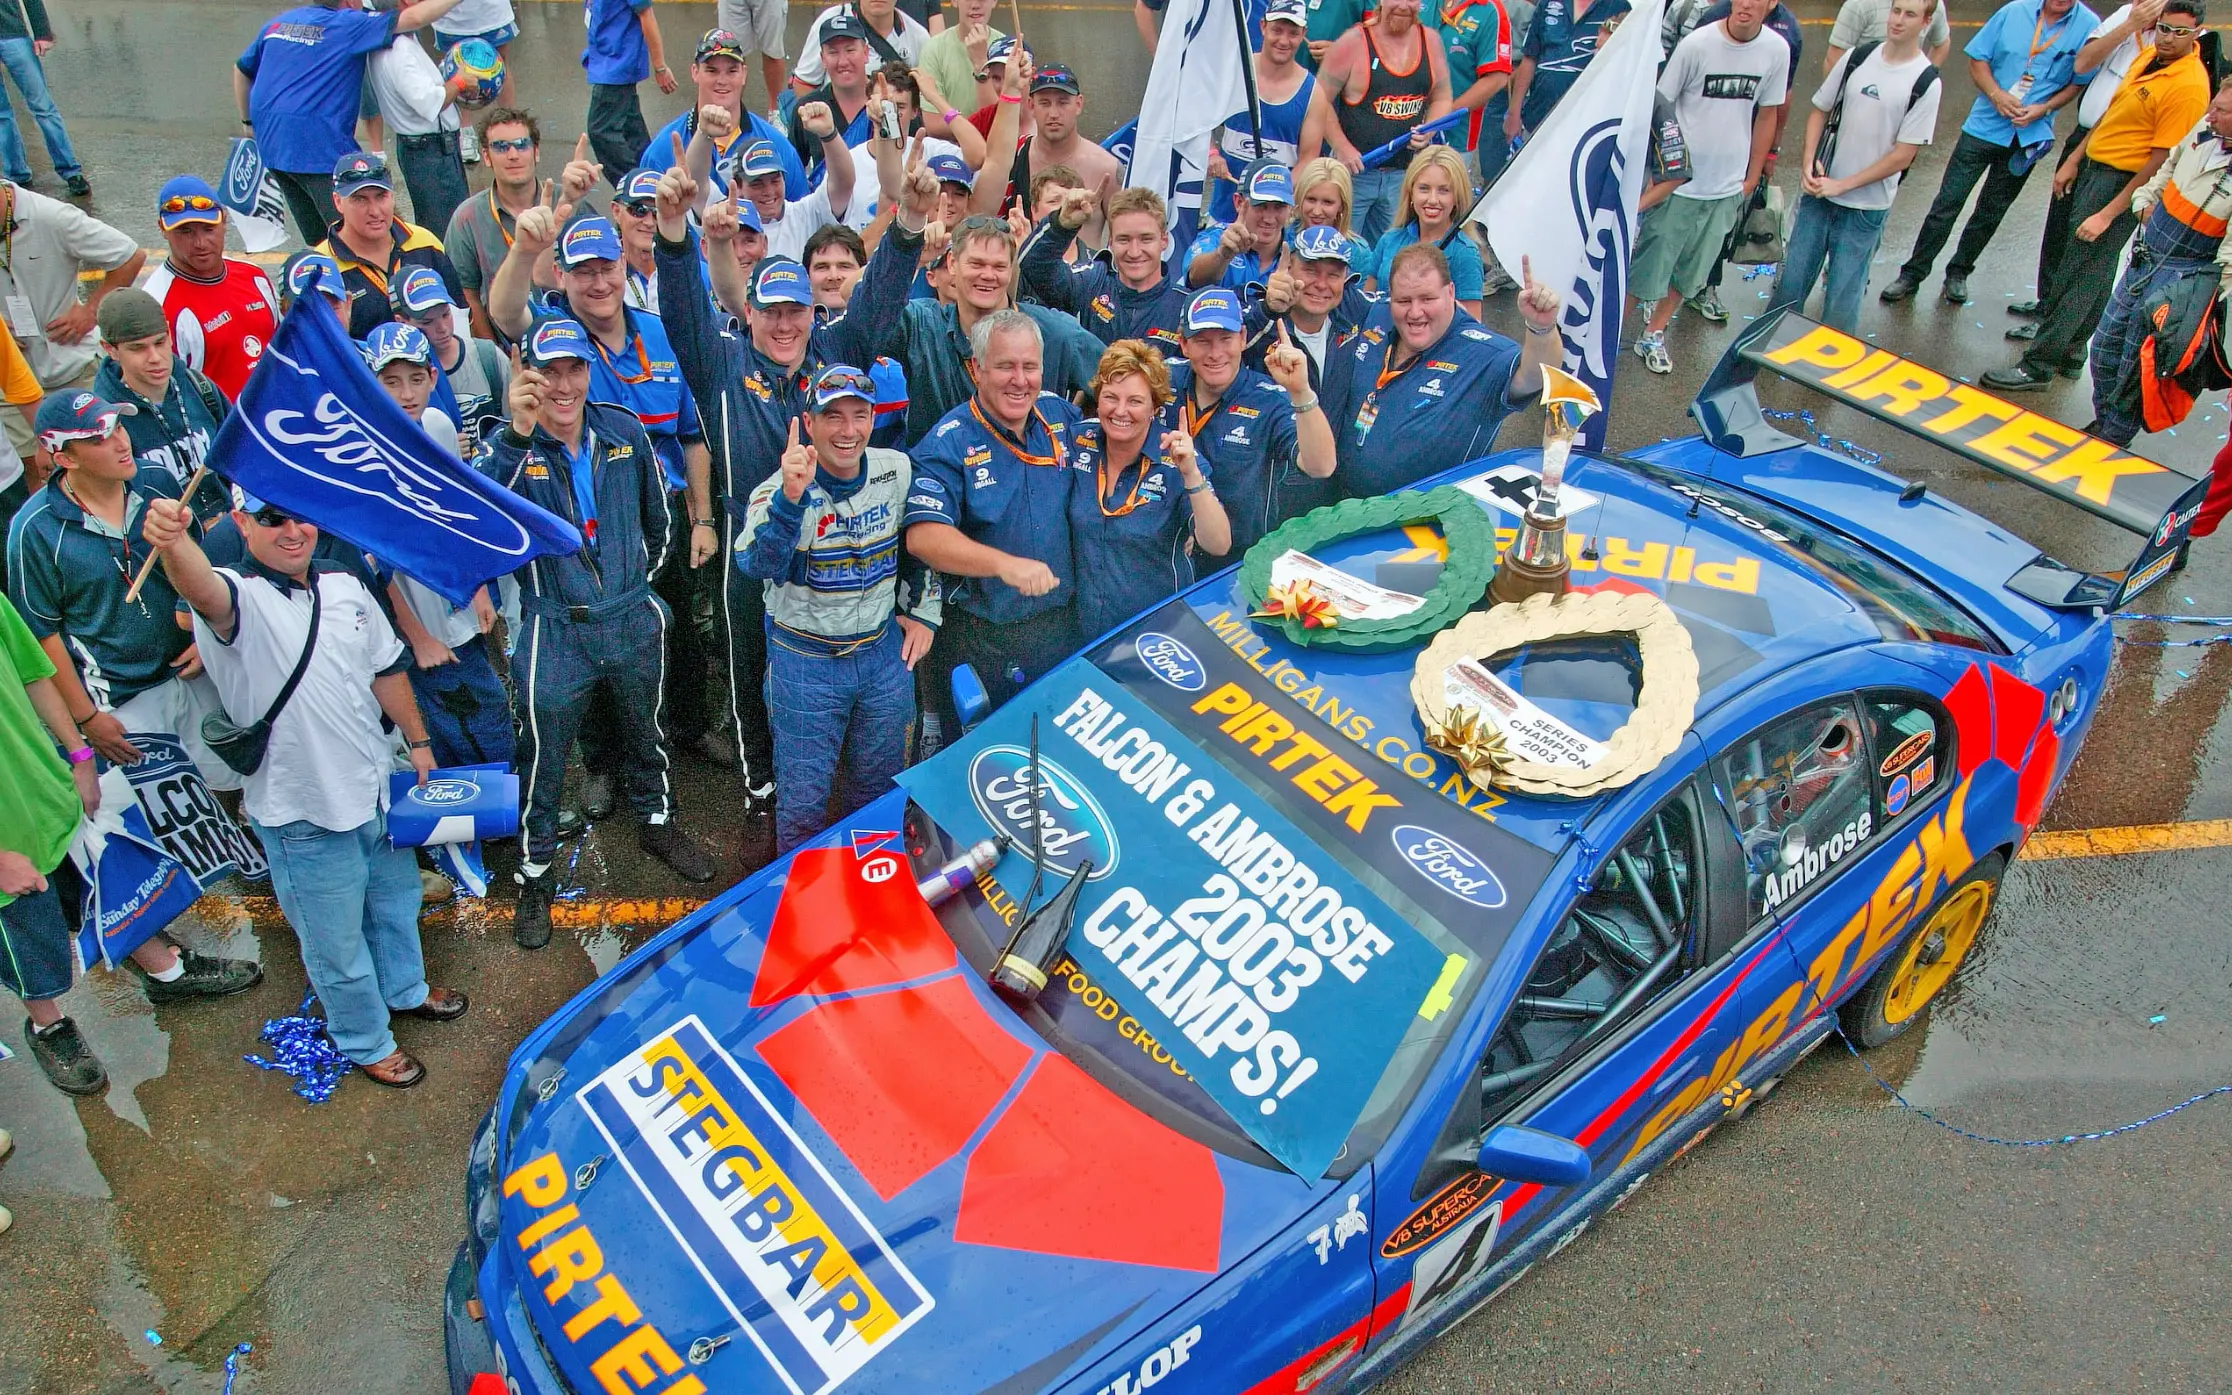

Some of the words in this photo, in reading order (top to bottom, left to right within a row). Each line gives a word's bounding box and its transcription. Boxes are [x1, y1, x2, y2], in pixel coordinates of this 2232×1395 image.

[282, 34, 316, 46] Racing
[234, 147, 258, 191] Ford
[769, 271, 798, 281] PIRTEK
[1199, 298, 1228, 308] PIRTEK
[1426, 378, 1441, 389] 4
[1231, 425, 1246, 438] 4
[1763, 323, 2170, 507] PIRTEK
[264, 392, 479, 522] Ford
[975, 467, 990, 481] 9
[1077, 452, 1092, 464] 9
[1148, 473, 1165, 486] 4
[836, 501, 892, 533] PIRTEK
[1669, 483, 1789, 543] BOSCH
[1142, 641, 1196, 682] Ford
[1205, 610, 1509, 823] MILLIGANS.CO.NZ
[1532, 718, 1588, 753] SERIES
[1052, 687, 1191, 805] FALCON
[1189, 681, 1405, 834] PIRTEK
[1509, 718, 1592, 770] CHAMPION
[1519, 739, 1559, 764] 2003
[423, 784, 465, 801] Ford
[984, 765, 1091, 858] Ford
[1164, 779, 1216, 825] &
[867, 860, 892, 880] E
[1407, 837, 1489, 895] Ford
[1761, 811, 1873, 917] Ambrose
[100, 896, 140, 929] Sunday
[1189, 801, 1395, 984] AMBROSE
[1172, 873, 1323, 1013] 2003
[1615, 772, 1976, 1171] PIRTEK
[1053, 958, 1120, 1022] FOOD
[1117, 1015, 1195, 1083] GROU
[1082, 886, 1319, 1116] CHAMPS!
[627, 1054, 872, 1347] STEGBAR
[1386, 1228, 1413, 1250] V8
[1412, 1173, 1493, 1234] SUPERCA
[1431, 1194, 1479, 1232] AUSTRALIA
[502, 1150, 709, 1395] PIRTE
